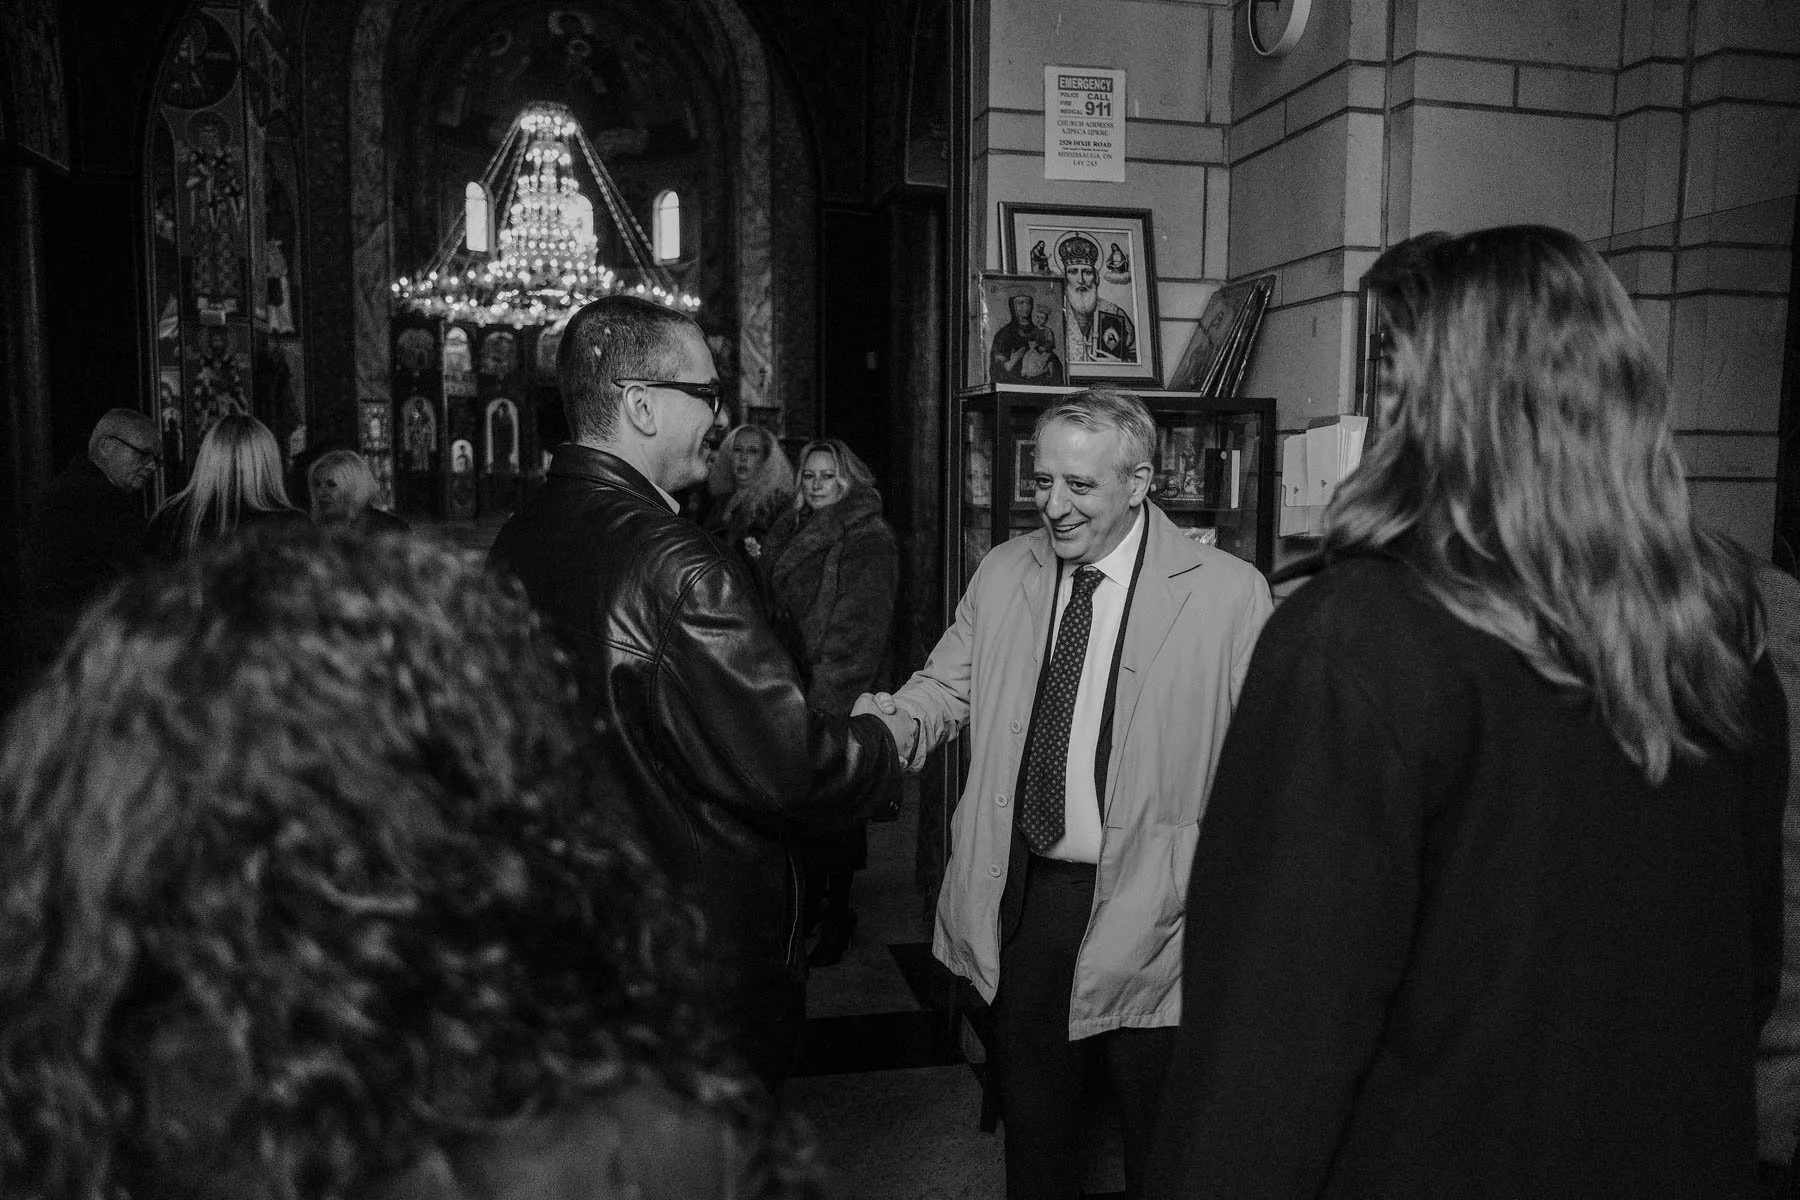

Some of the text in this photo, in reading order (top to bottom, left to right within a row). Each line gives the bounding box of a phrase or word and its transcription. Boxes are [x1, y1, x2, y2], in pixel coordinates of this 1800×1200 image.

[1059, 77, 1112, 91] EMERGENCY
[1087, 93, 1111, 101] CALL
[1085, 101, 1111, 116] 911
